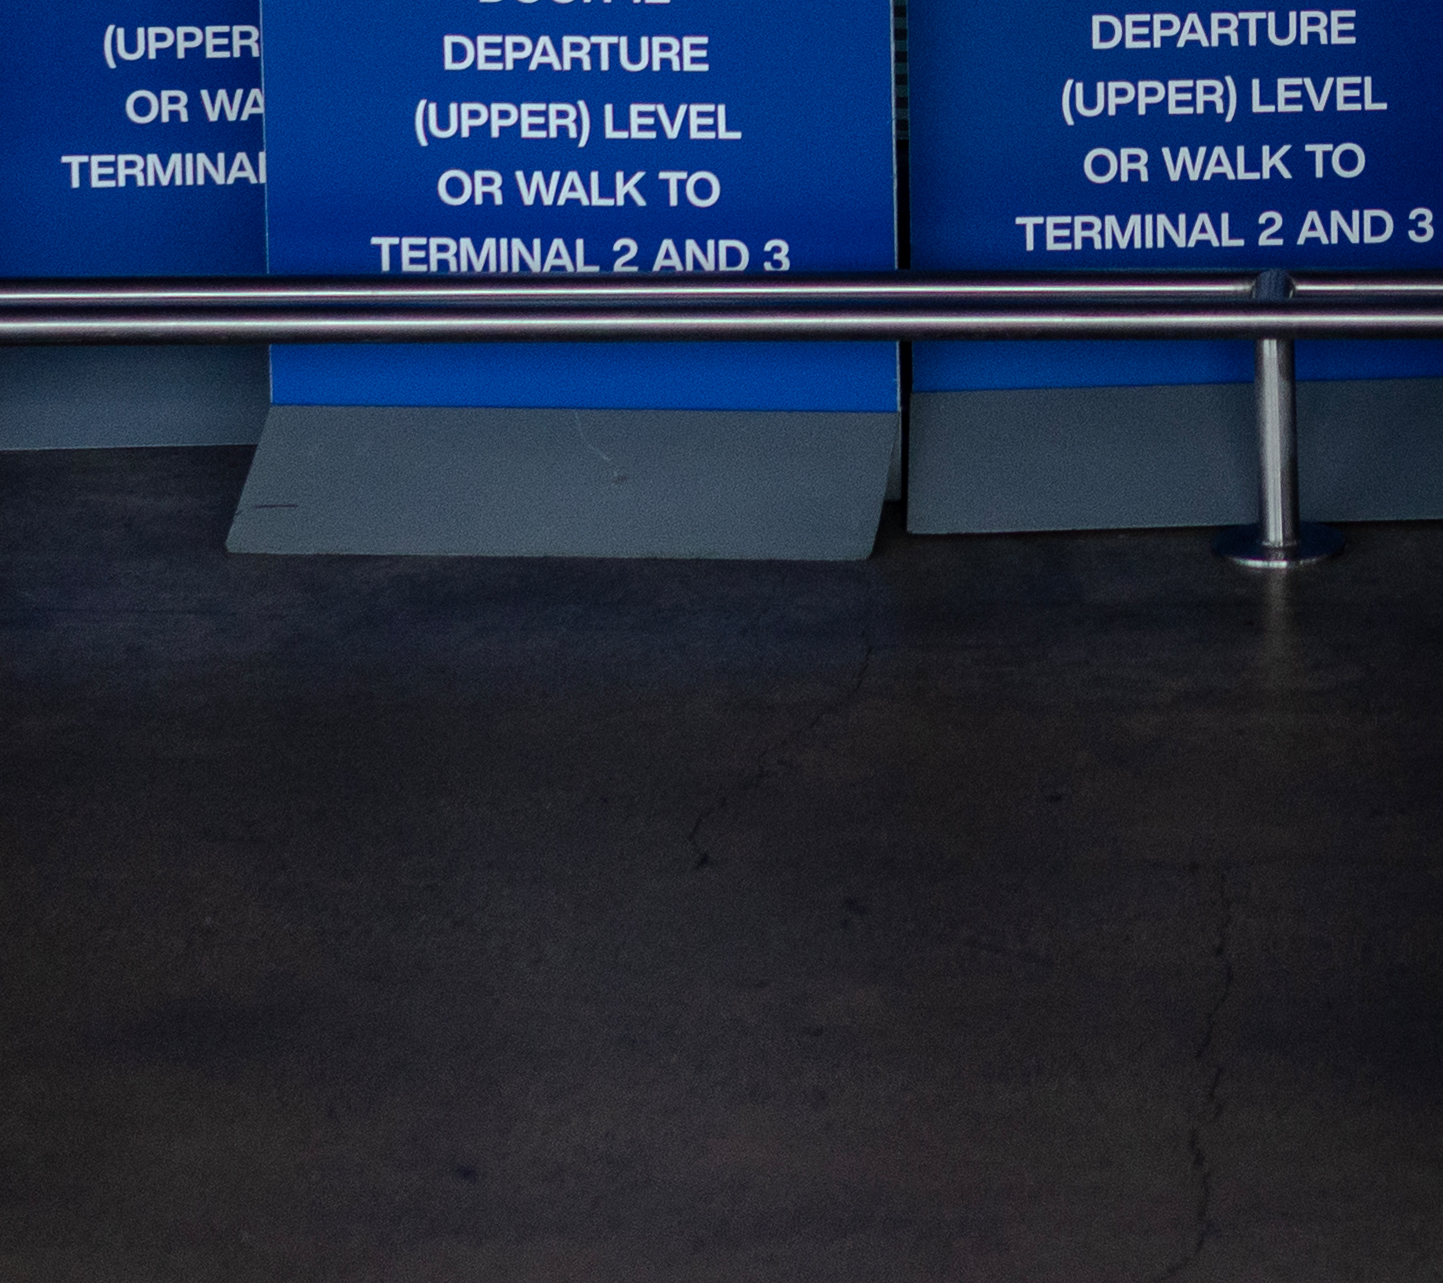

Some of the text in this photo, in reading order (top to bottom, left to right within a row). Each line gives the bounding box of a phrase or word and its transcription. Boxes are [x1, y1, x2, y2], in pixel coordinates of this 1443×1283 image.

[1093, 11, 1355, 49] DEPARTURE
[445, 36, 708, 70] DEPARTURE
[1062, 76, 1387, 125] (UPPER) LEVEL
[1084, 143, 1365, 183] OR WALK TO
[1016, 208, 1434, 250] TERMINAL 2 AND 3
